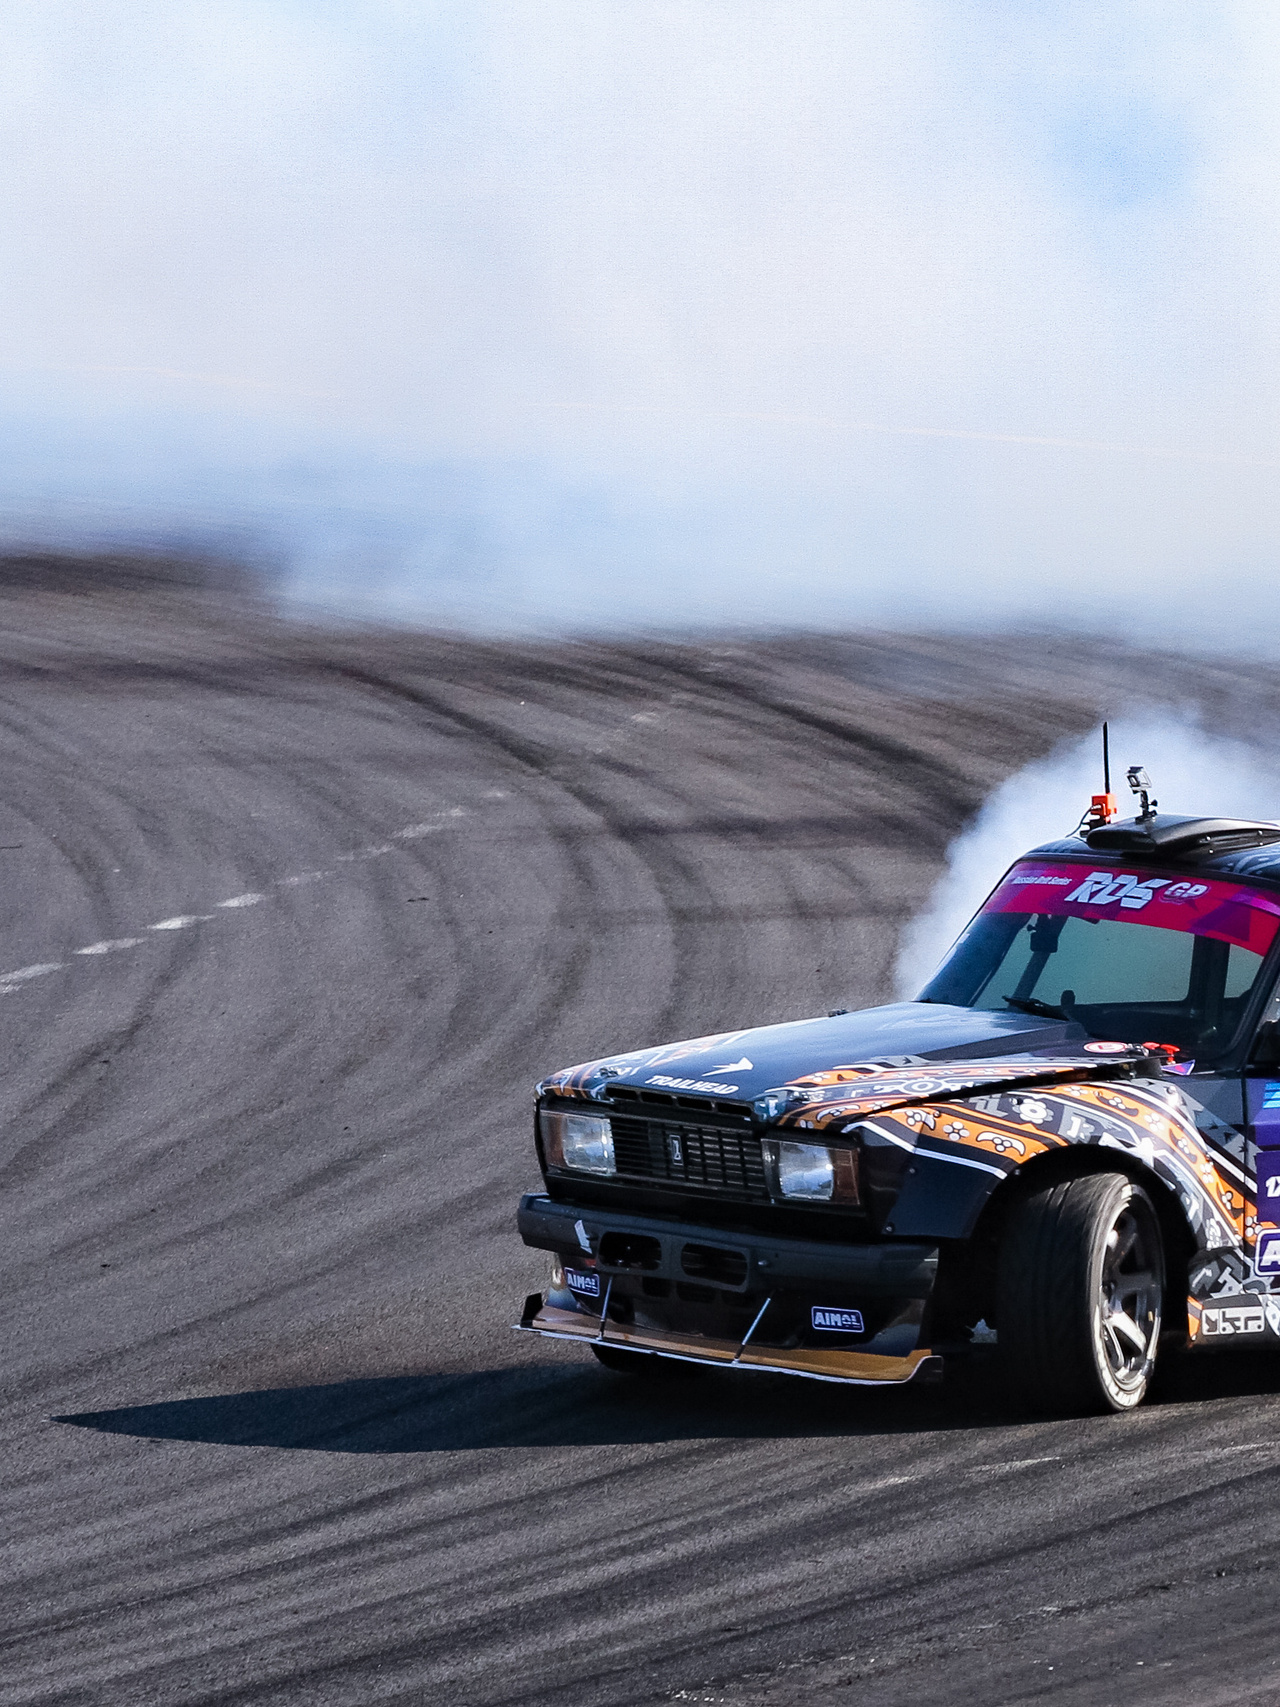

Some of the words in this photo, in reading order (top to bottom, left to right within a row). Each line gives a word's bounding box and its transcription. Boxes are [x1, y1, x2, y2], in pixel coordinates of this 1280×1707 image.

[1064, 872, 1173, 909] RDS
[1163, 882, 1208, 899] GP
[644, 1075, 739, 1094] TRAILHEAD
[567, 1270, 598, 1294] AIMOL
[814, 1310, 861, 1329] AIMOL
